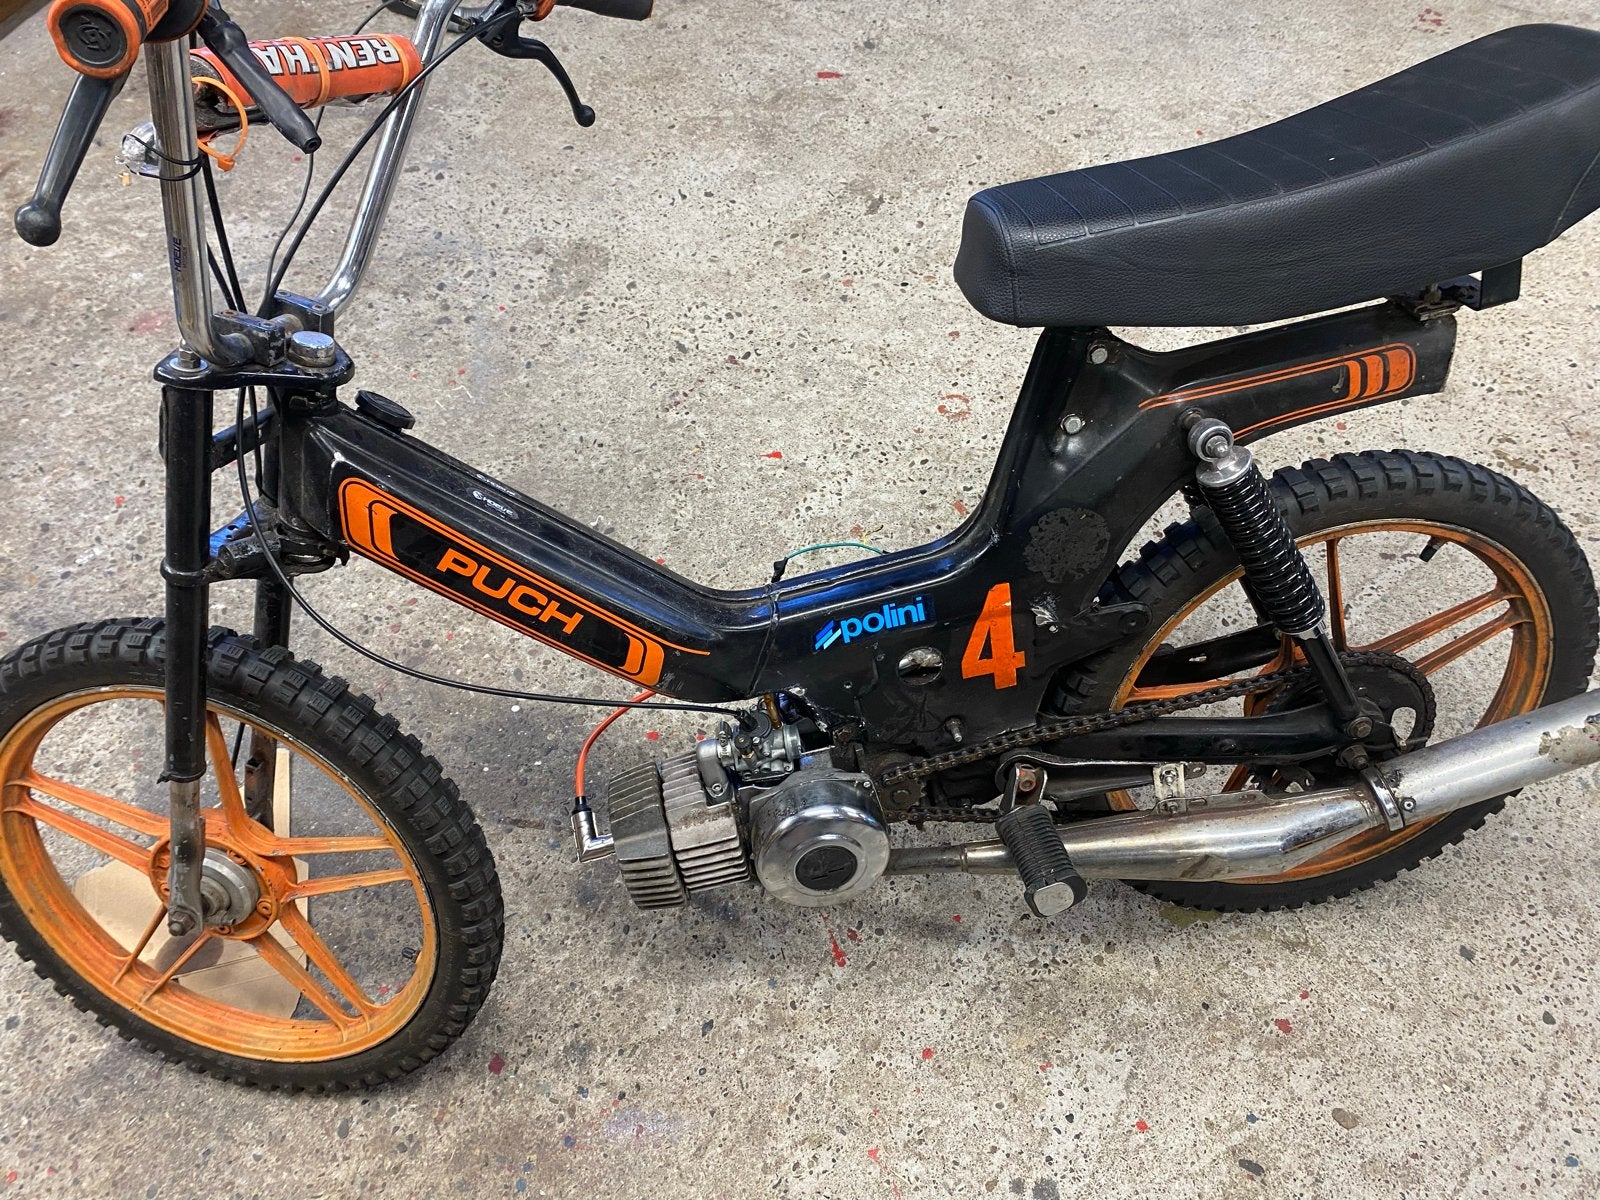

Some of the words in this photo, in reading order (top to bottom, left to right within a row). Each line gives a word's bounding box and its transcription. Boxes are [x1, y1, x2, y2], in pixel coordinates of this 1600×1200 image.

[250, 37, 400, 75] RENHA
[436, 547, 584, 635] PUCH
[840, 596, 926, 644] polini
[961, 582, 1026, 690] 4
